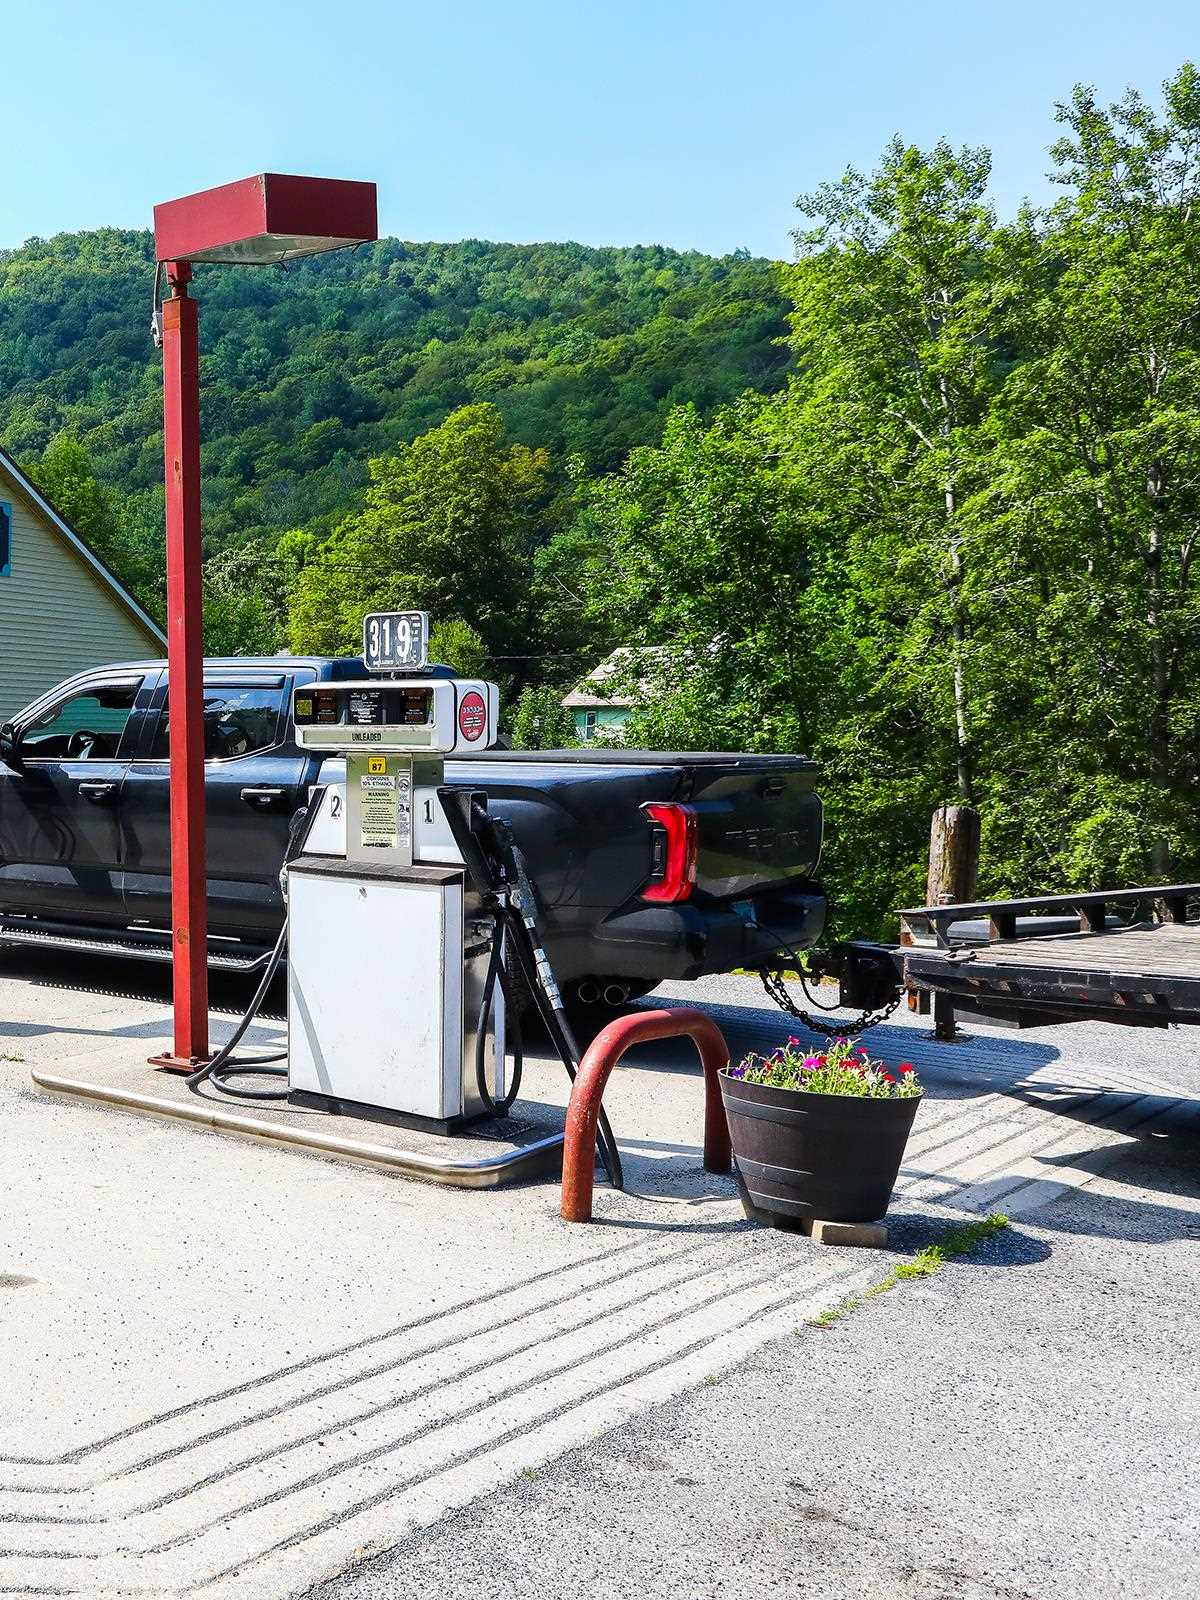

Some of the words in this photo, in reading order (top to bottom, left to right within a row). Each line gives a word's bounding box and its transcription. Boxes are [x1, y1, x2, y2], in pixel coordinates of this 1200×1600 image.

[351, 732, 382, 742] UNLEADED
[371, 762, 383, 771] 87
[330, 795, 341, 818] 2
[423, 799, 433, 823] 1
